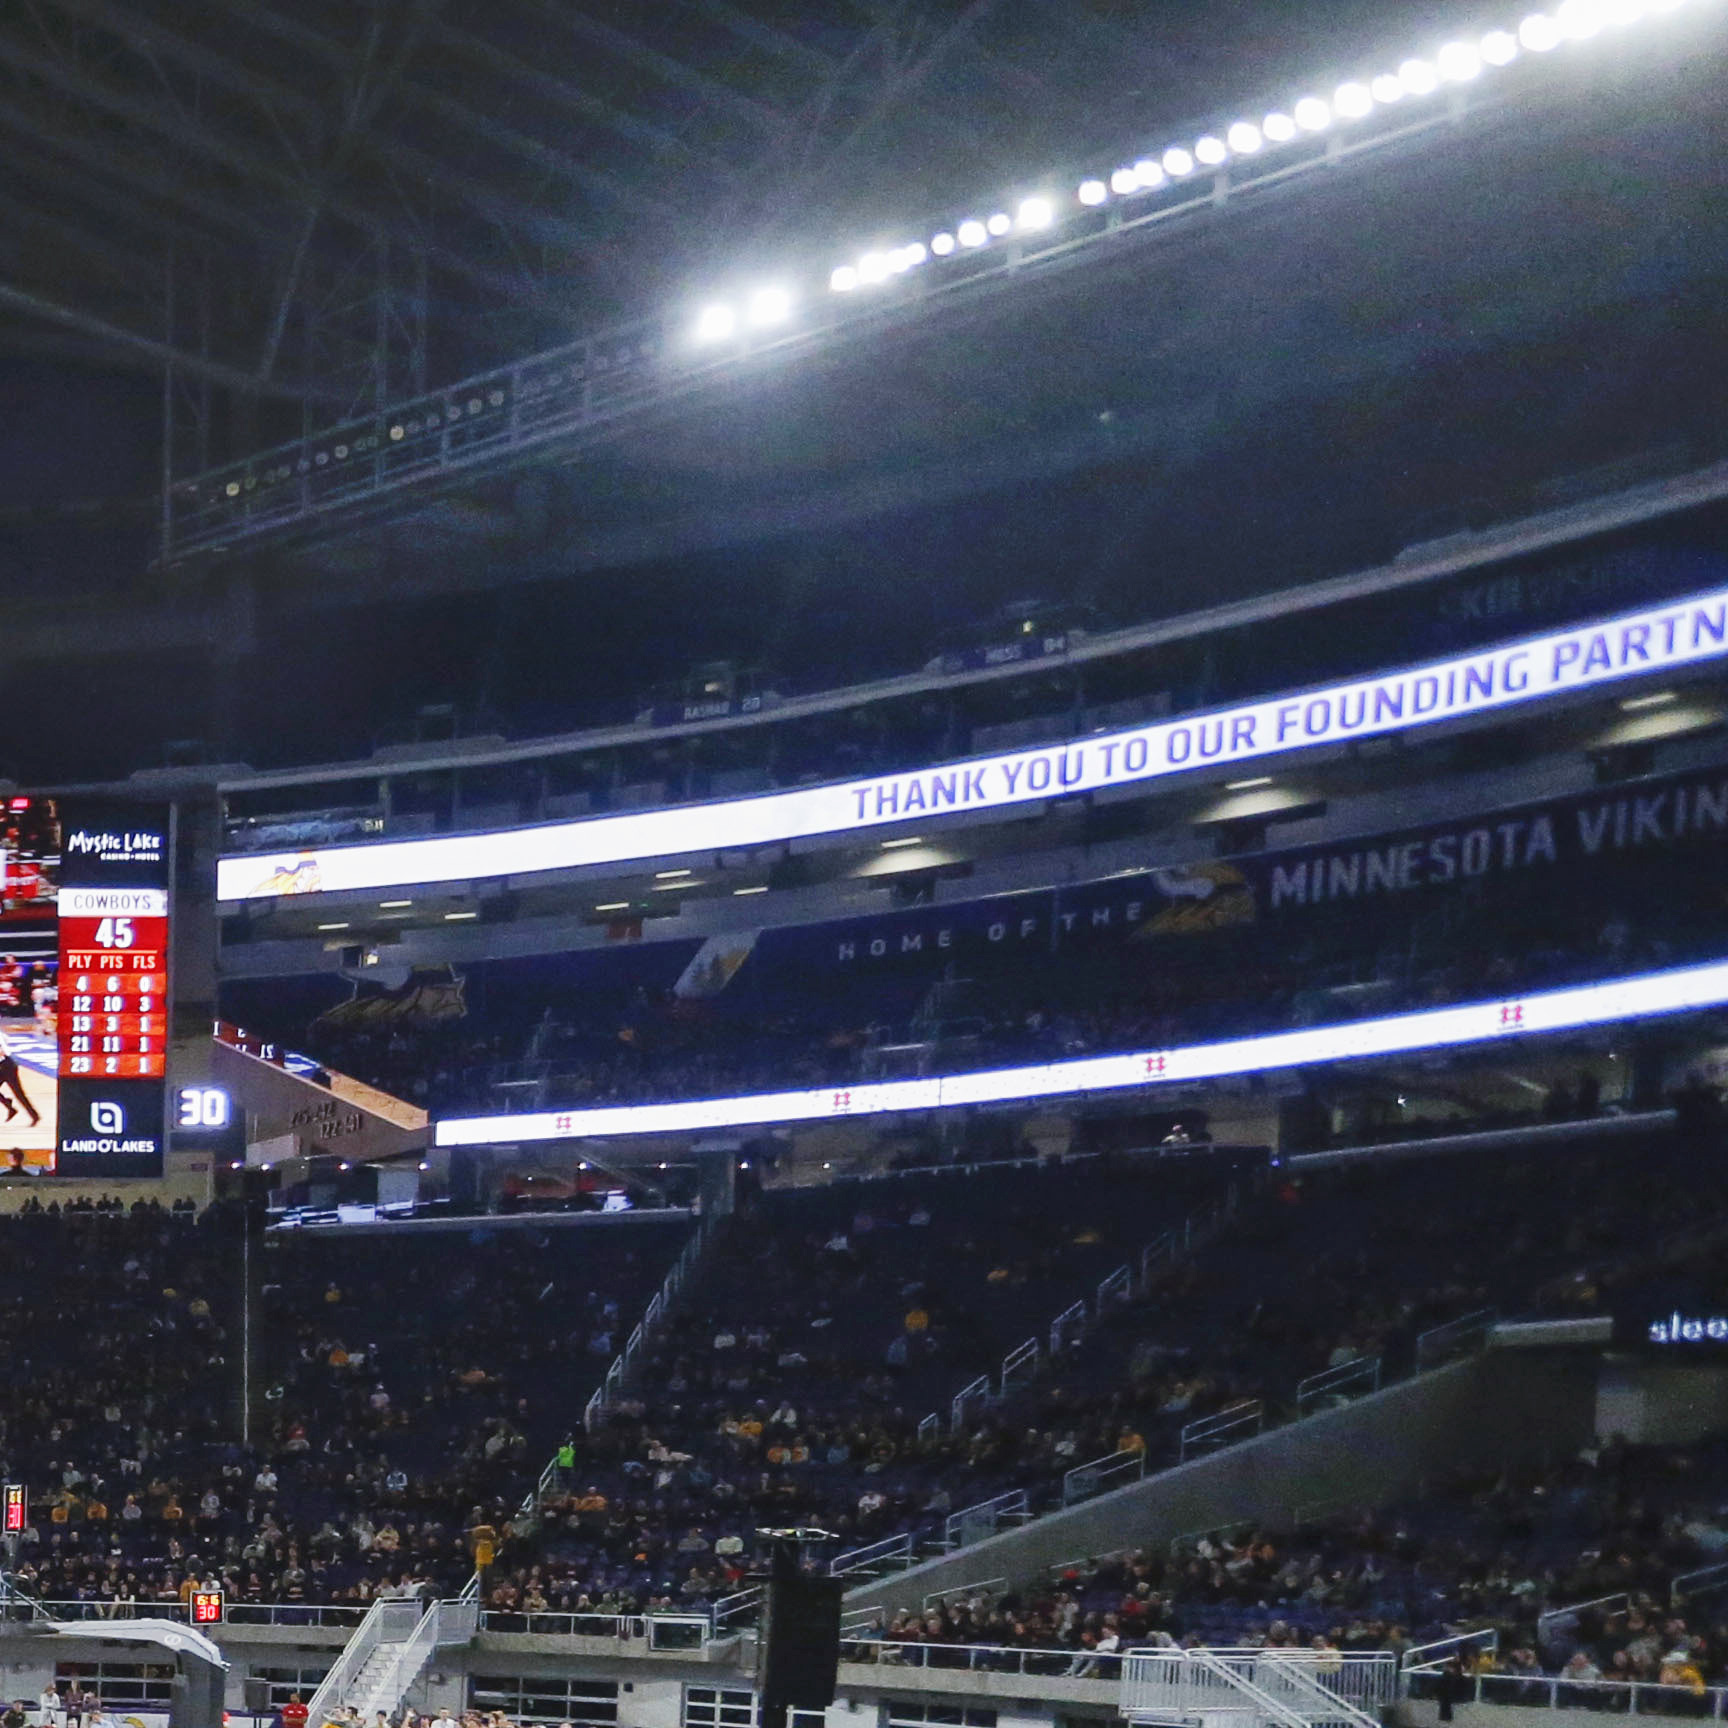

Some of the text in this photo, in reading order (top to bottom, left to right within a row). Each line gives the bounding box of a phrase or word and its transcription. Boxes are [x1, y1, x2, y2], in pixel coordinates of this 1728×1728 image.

[851, 766, 986, 820] THANK
[999, 752, 1084, 797] YOU
[1096, 742, 1148, 780] TO
[1164, 716, 1259, 766] OUR
[1274, 654, 1531, 745] FOUNDING
[1268, 814, 1557, 911] MINNESOTA
[74, 894, 151, 910] COWBOYS
[95, 918, 134, 948] 45
[838, 901, 1143, 961] HOME OF THE
[68, 955, 156, 969] PLY PTS FLS
[76, 976, 89, 992] 4
[107, 976, 118, 992] 6
[72, 995, 150, 1012] 12 10 3
[72, 1015, 149, 1032] 13 3 1
[71, 1035, 149, 1052] 21 11 1
[71, 1056, 149, 1073] 23 2 1
[180, 1090, 226, 1126] 30
[198, 1605, 217, 1620] 30
